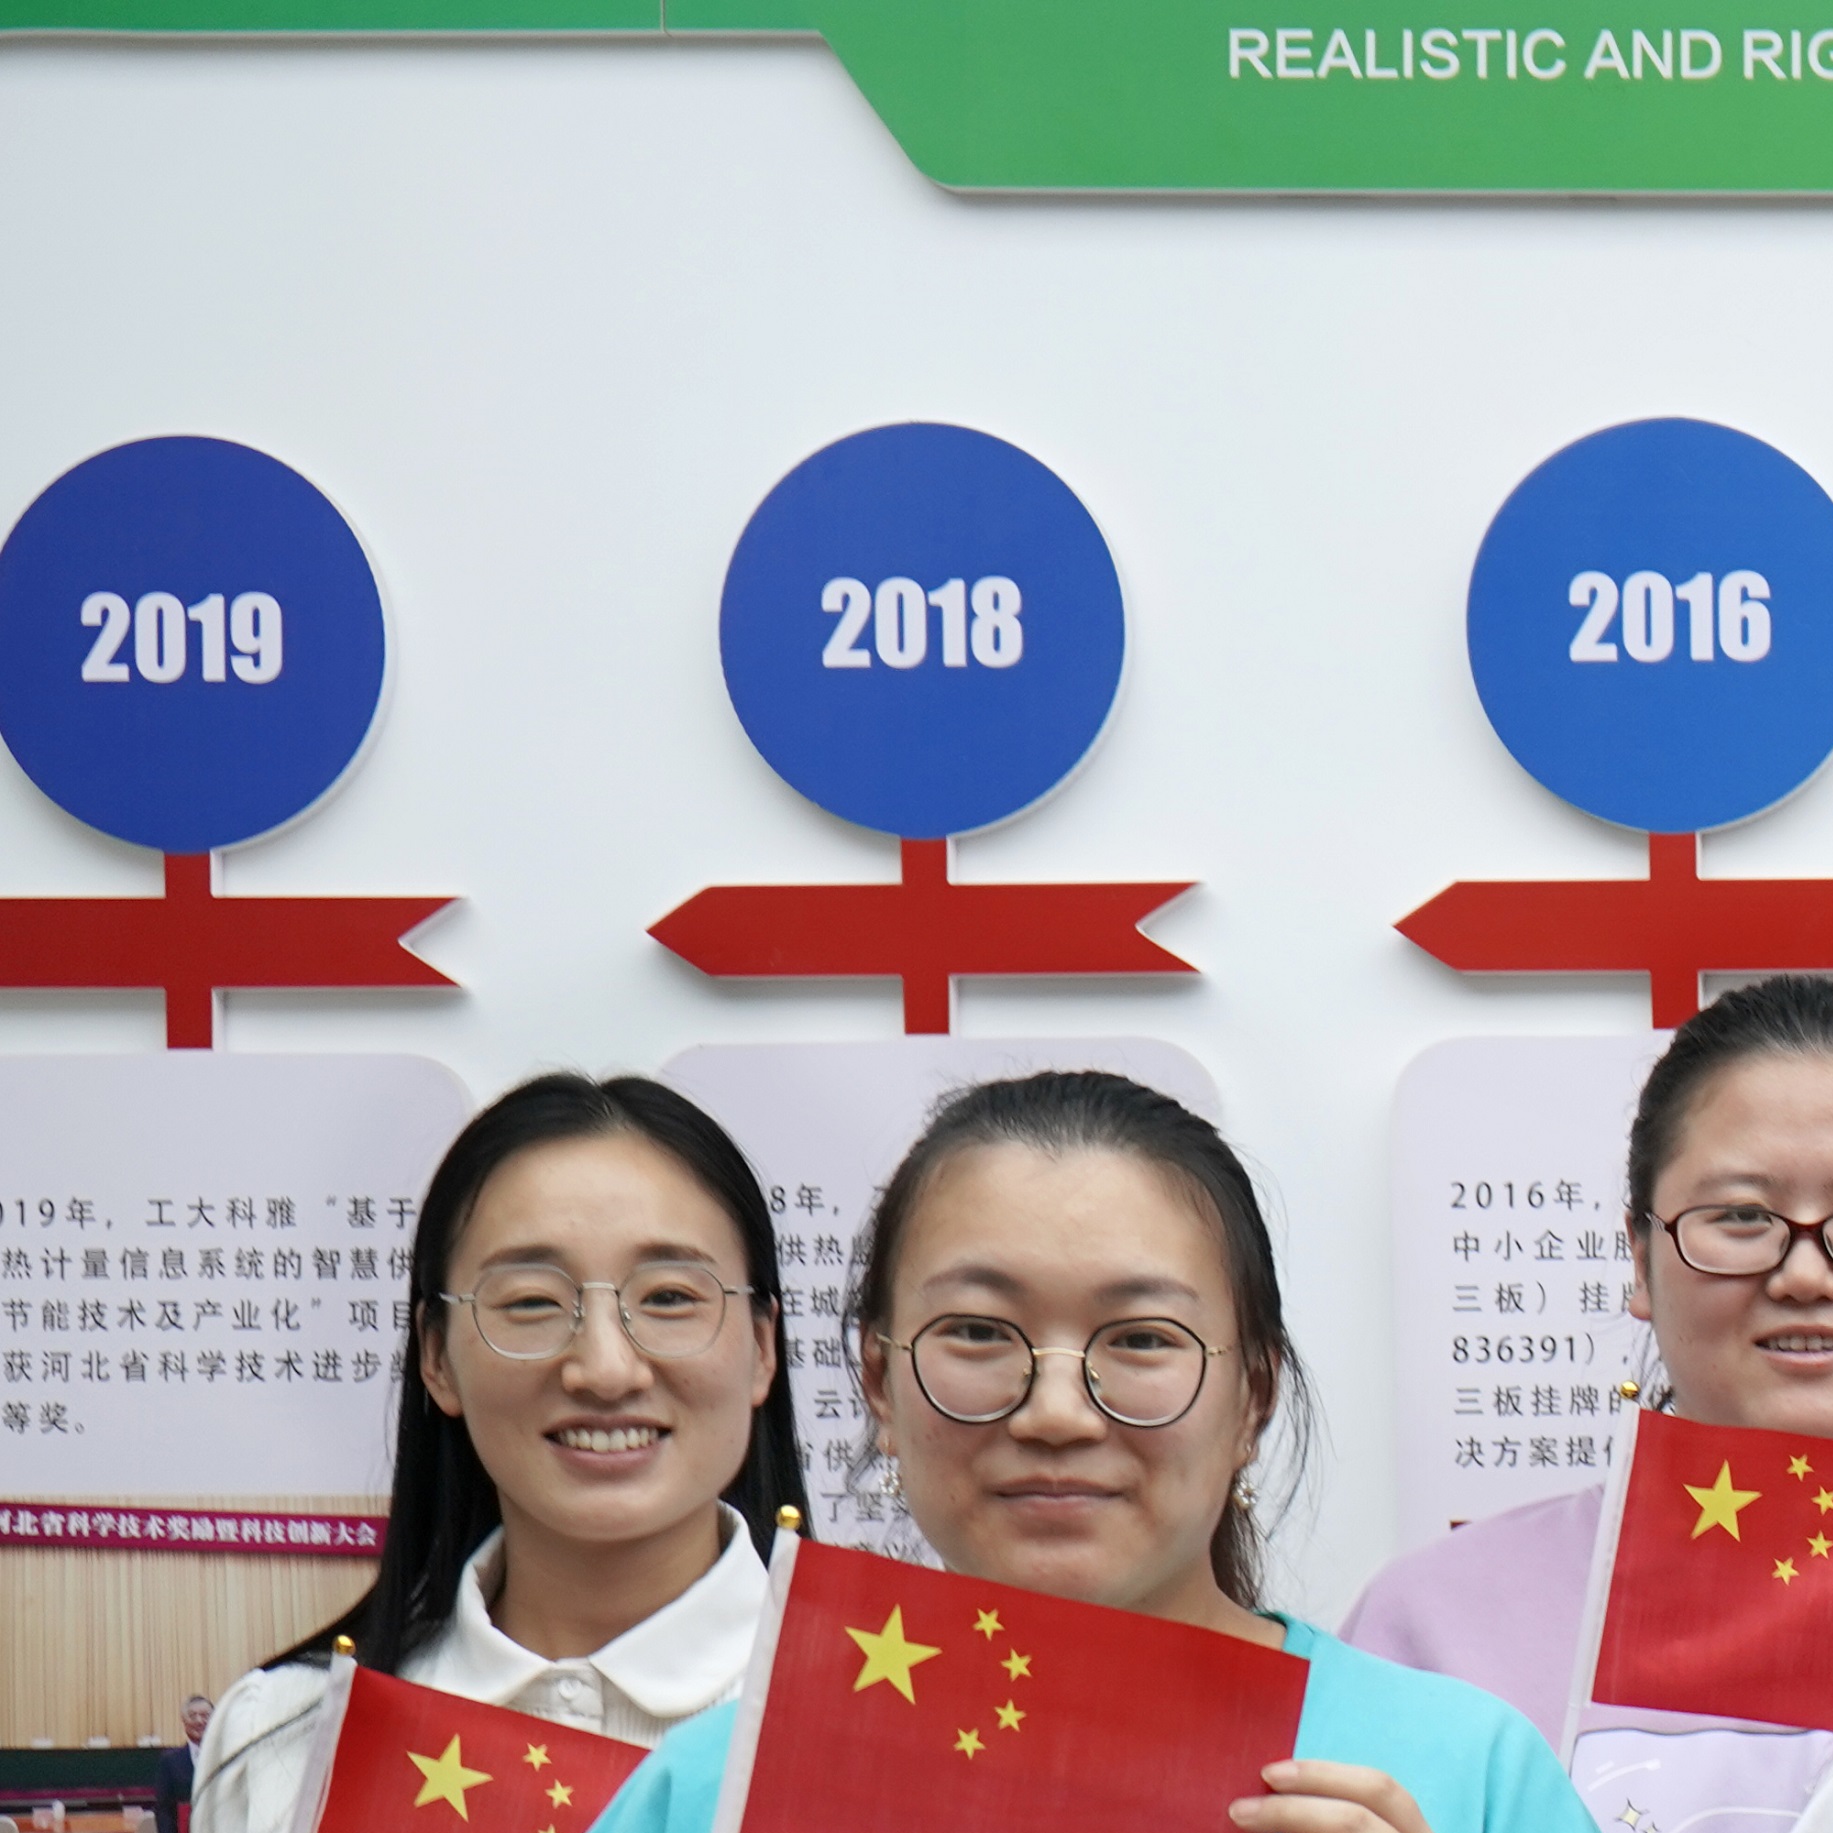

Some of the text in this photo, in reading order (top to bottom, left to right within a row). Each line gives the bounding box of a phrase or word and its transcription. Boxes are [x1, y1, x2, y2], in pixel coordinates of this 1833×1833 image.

[1228, 28, 1567, 80] REALISTIC
[1584, 29, 1722, 80] AND
[80, 592, 284, 684] 2019
[820, 576, 1024, 669] 2018
[1568, 570, 1773, 664] 2016
[0, 1195, 418, 1230] 19年，工大科雅“基于
